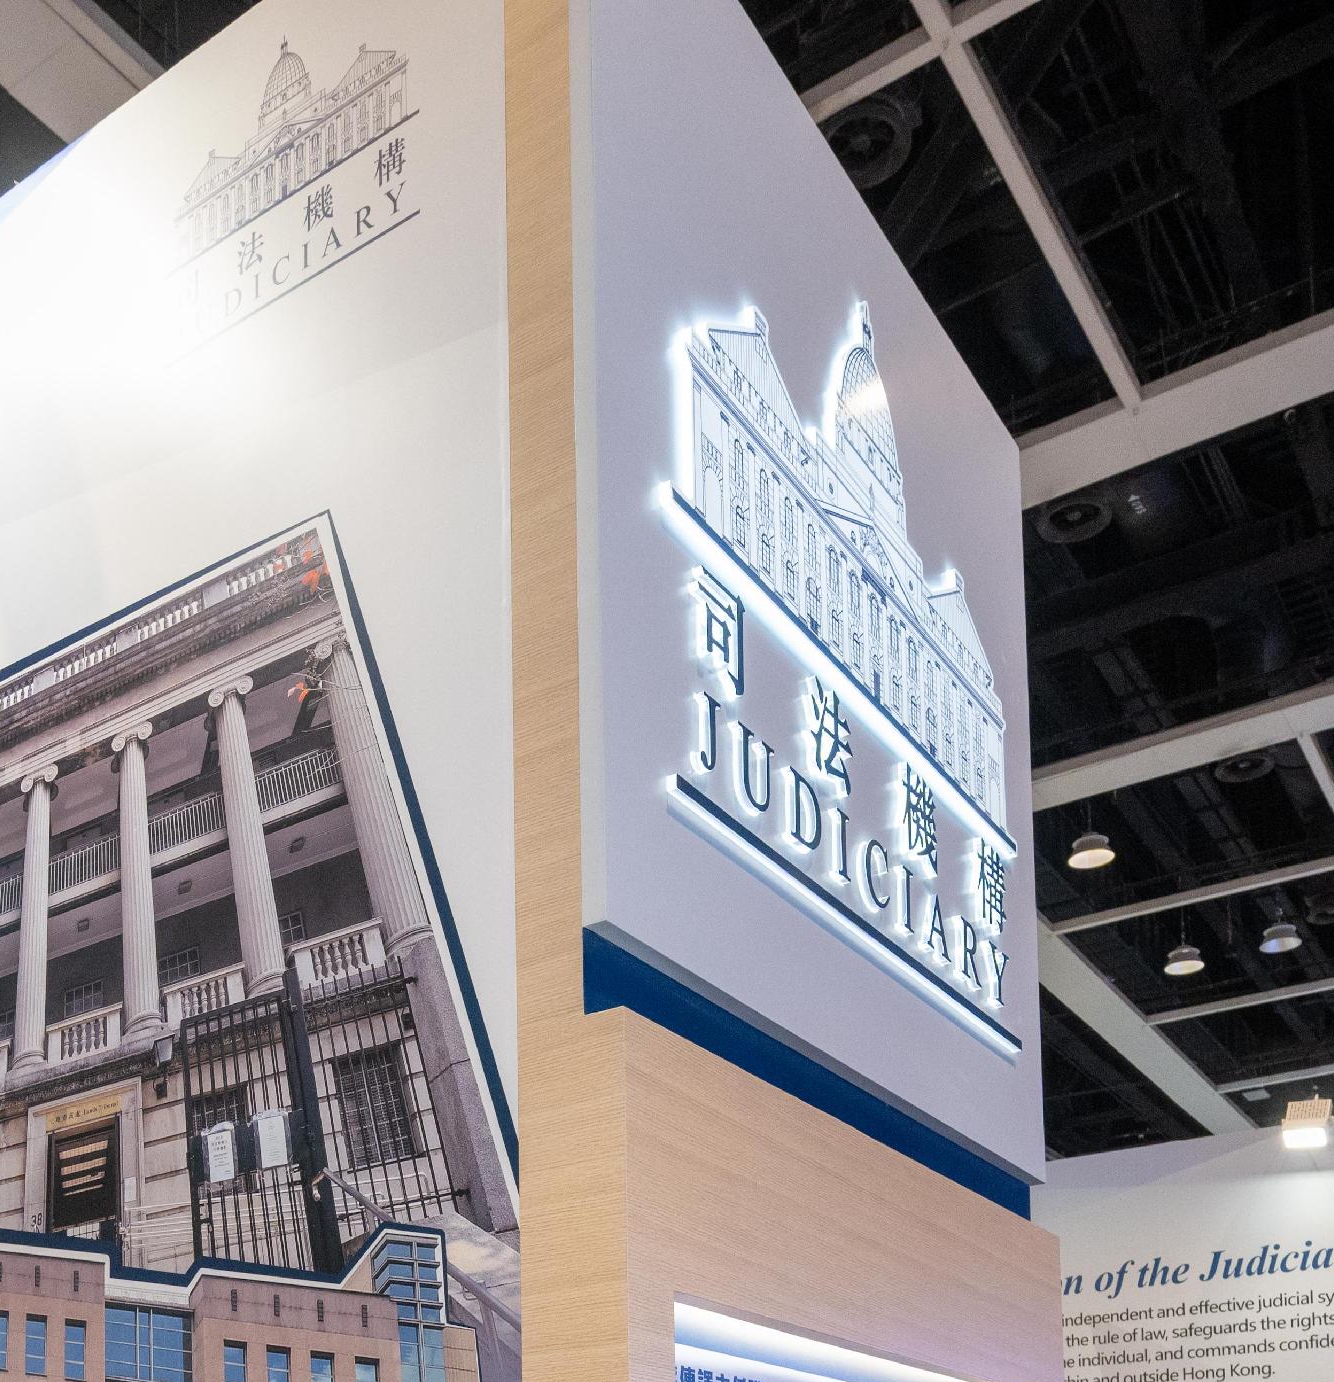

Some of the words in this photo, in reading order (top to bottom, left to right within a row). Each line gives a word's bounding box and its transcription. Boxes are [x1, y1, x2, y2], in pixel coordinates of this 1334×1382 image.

[236, 137, 406, 276] 法機構
[695, 567, 1006, 928] 司法機構
[694, 690, 1009, 1008] JUDICIARY
[1094, 1260, 1135, 1299] of
[1138, 1257, 1190, 1288] the
[1062, 1307, 1154, 1328] independent
[1157, 1303, 1186, 1320] and
[1189, 1296, 1256, 1316] effective
[1256, 1290, 1314, 1313] judicial
[1066, 1333, 1089, 1348] the
[1092, 1329, 1120, 1346] rule
[1122, 1327, 1140, 1343] of
[1141, 1325, 1169, 1343] law,
[1172, 1317, 1257, 1343] safeguards
[1261, 1315, 1287, 1332] the
[1078, 1347, 1151, 1368] individual,
[1155, 1345, 1184, 1362] and
[1187, 1338, 1276, 1360] commands
[1229, 1360, 1276, 1380] Kong.
